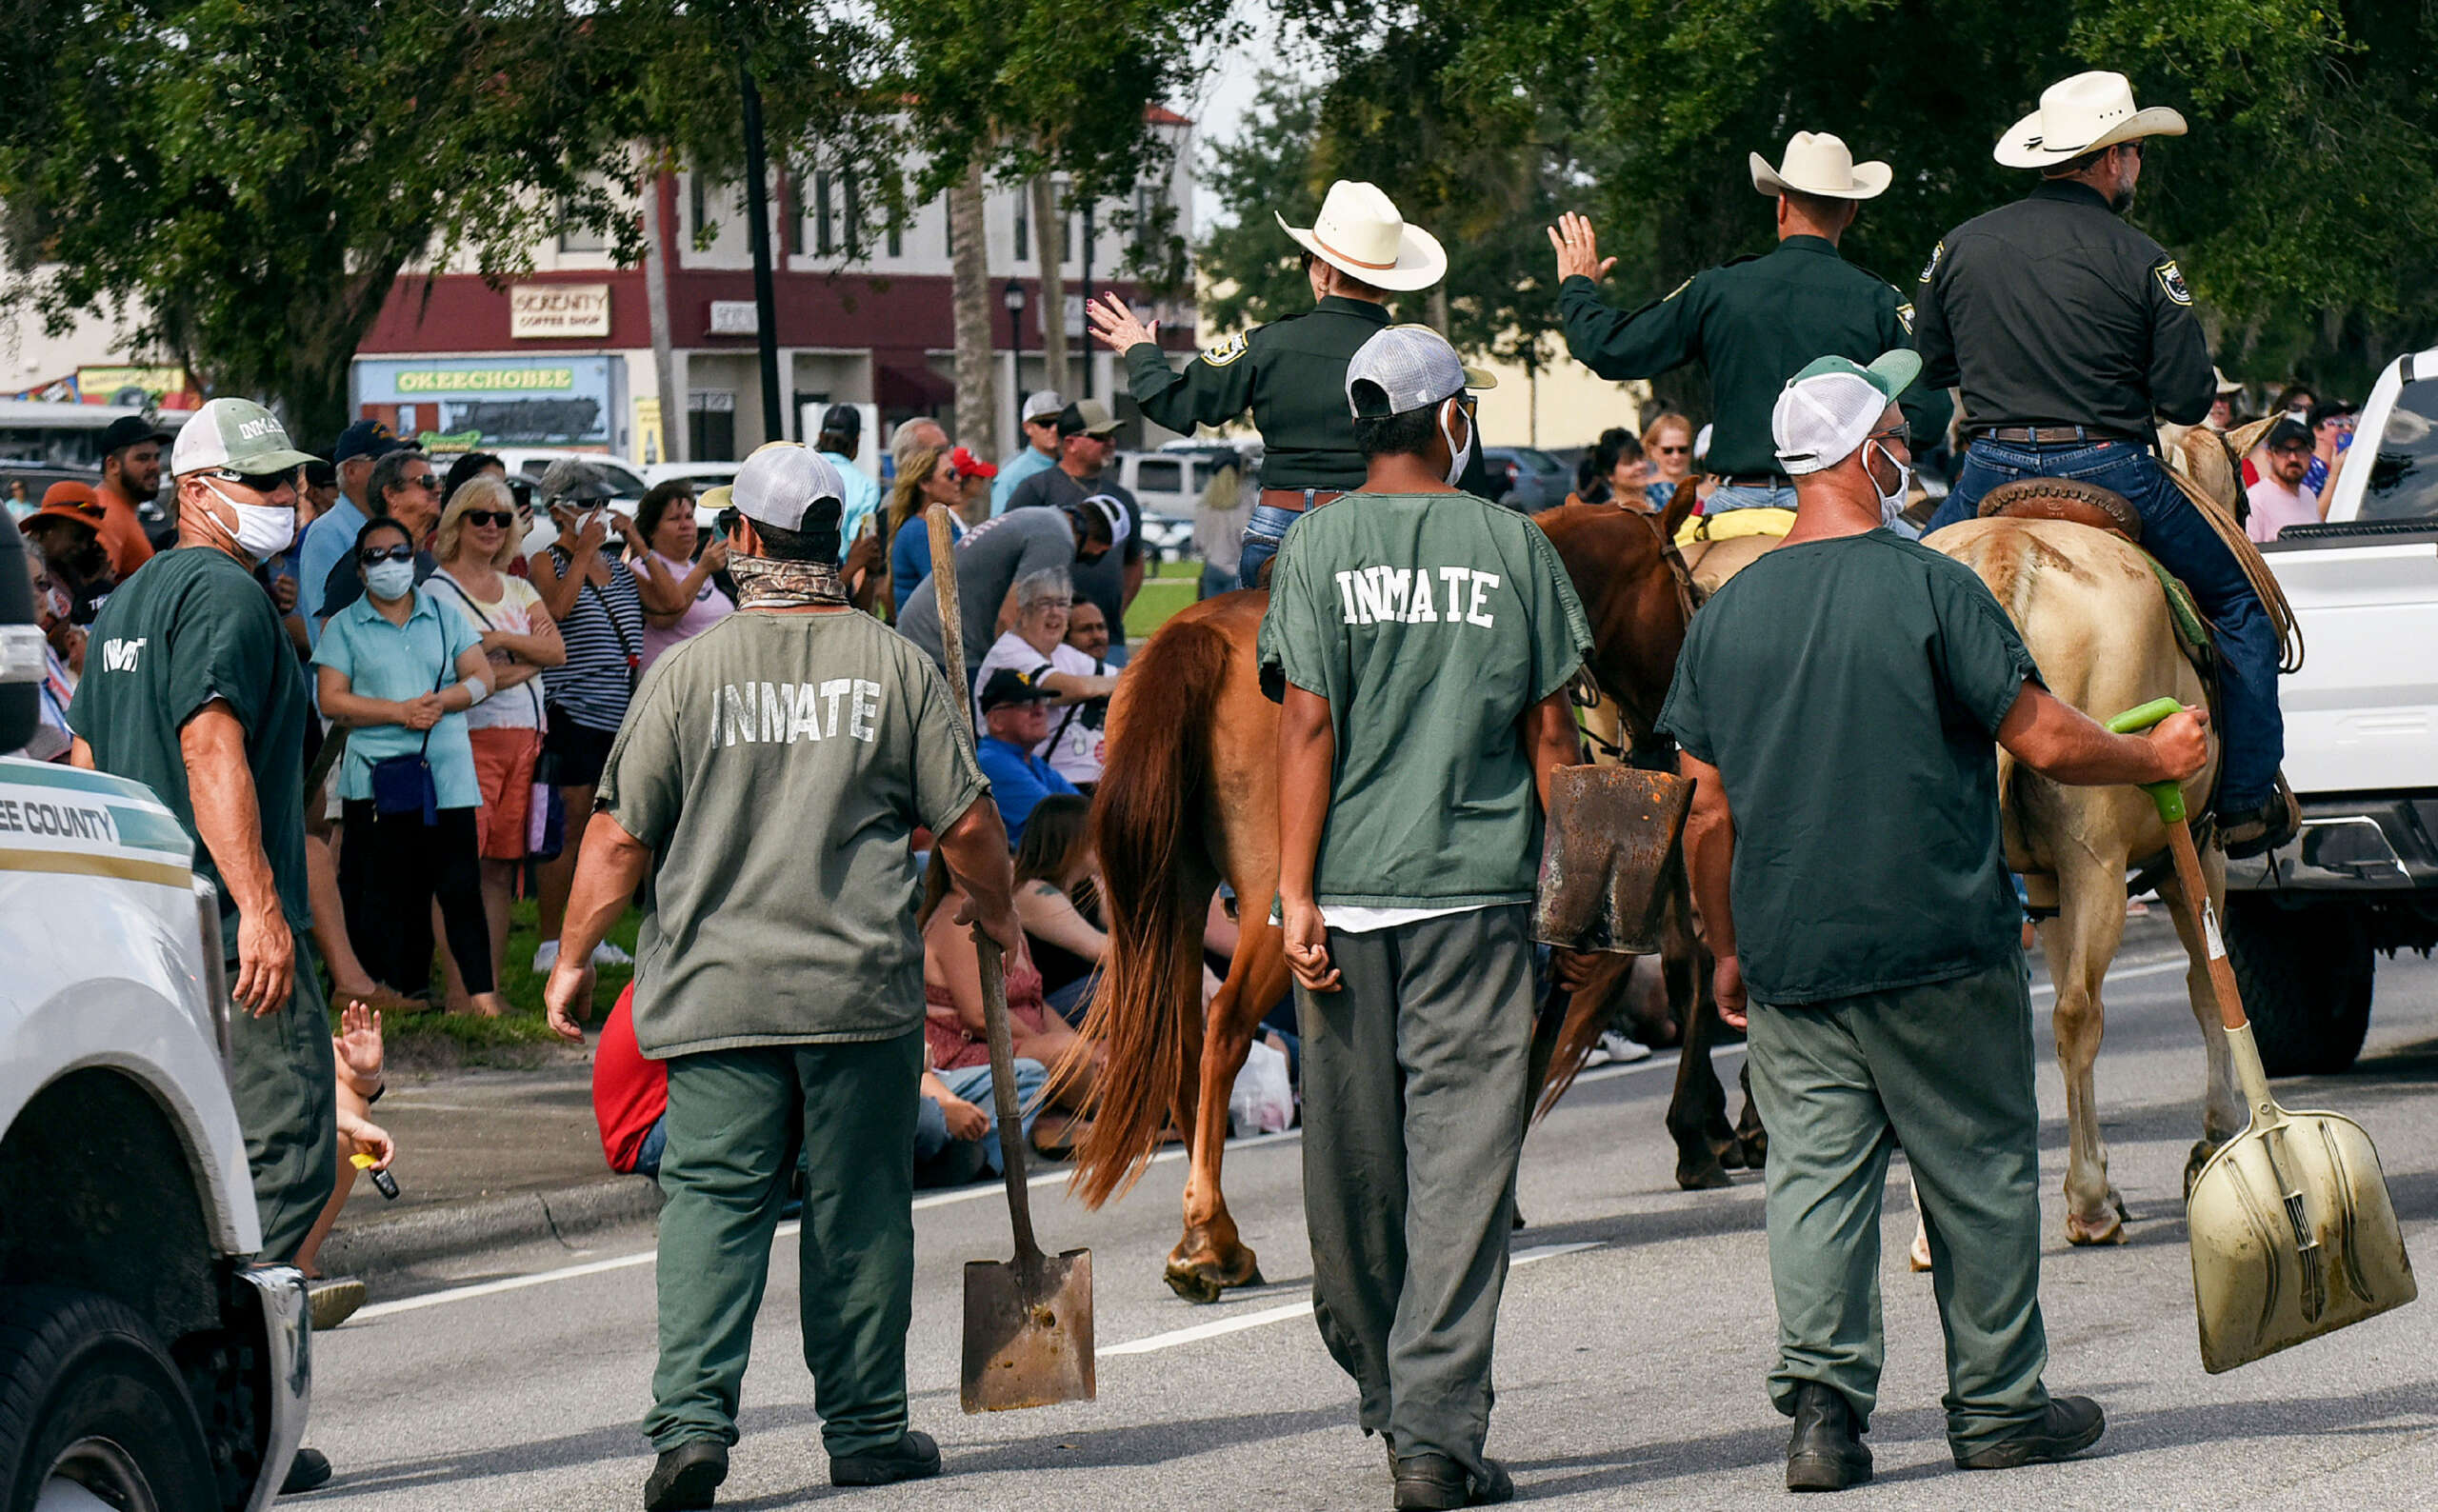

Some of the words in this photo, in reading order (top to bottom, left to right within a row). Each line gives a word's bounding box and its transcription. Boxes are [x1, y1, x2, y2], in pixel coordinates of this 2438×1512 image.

[515, 291, 609, 310] SERENITY
[520, 315, 565, 327] COFFEE
[398, 368, 571, 391] OKEECHOBEE
[1335, 566, 1500, 628] INMATE
[711, 678, 881, 749] INMATE
[24, 802, 112, 843] COUNTY
